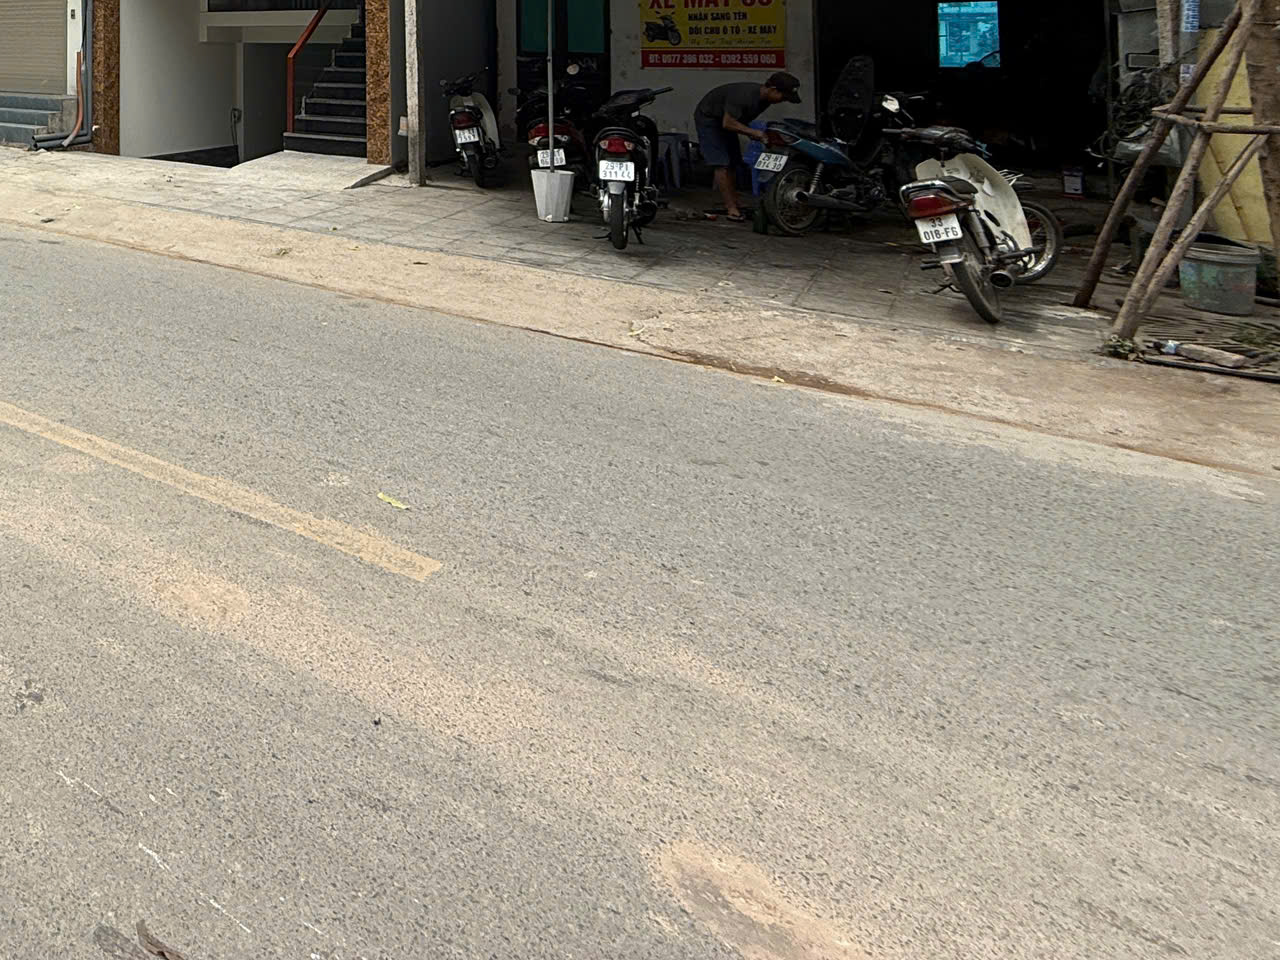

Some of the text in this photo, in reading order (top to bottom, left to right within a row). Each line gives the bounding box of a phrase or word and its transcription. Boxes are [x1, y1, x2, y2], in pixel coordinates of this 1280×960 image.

[731, 24, 741, 34] TÔ
[747, 25, 757, 34] XE
[662, 53, 680, 64] 0977
[682, 53, 697, 64] 396
[699, 53, 714, 64] 032
[721, 53, 741, 64] 0392
[742, 53, 758, 64] 559
[929, 217, 943, 227] 33
